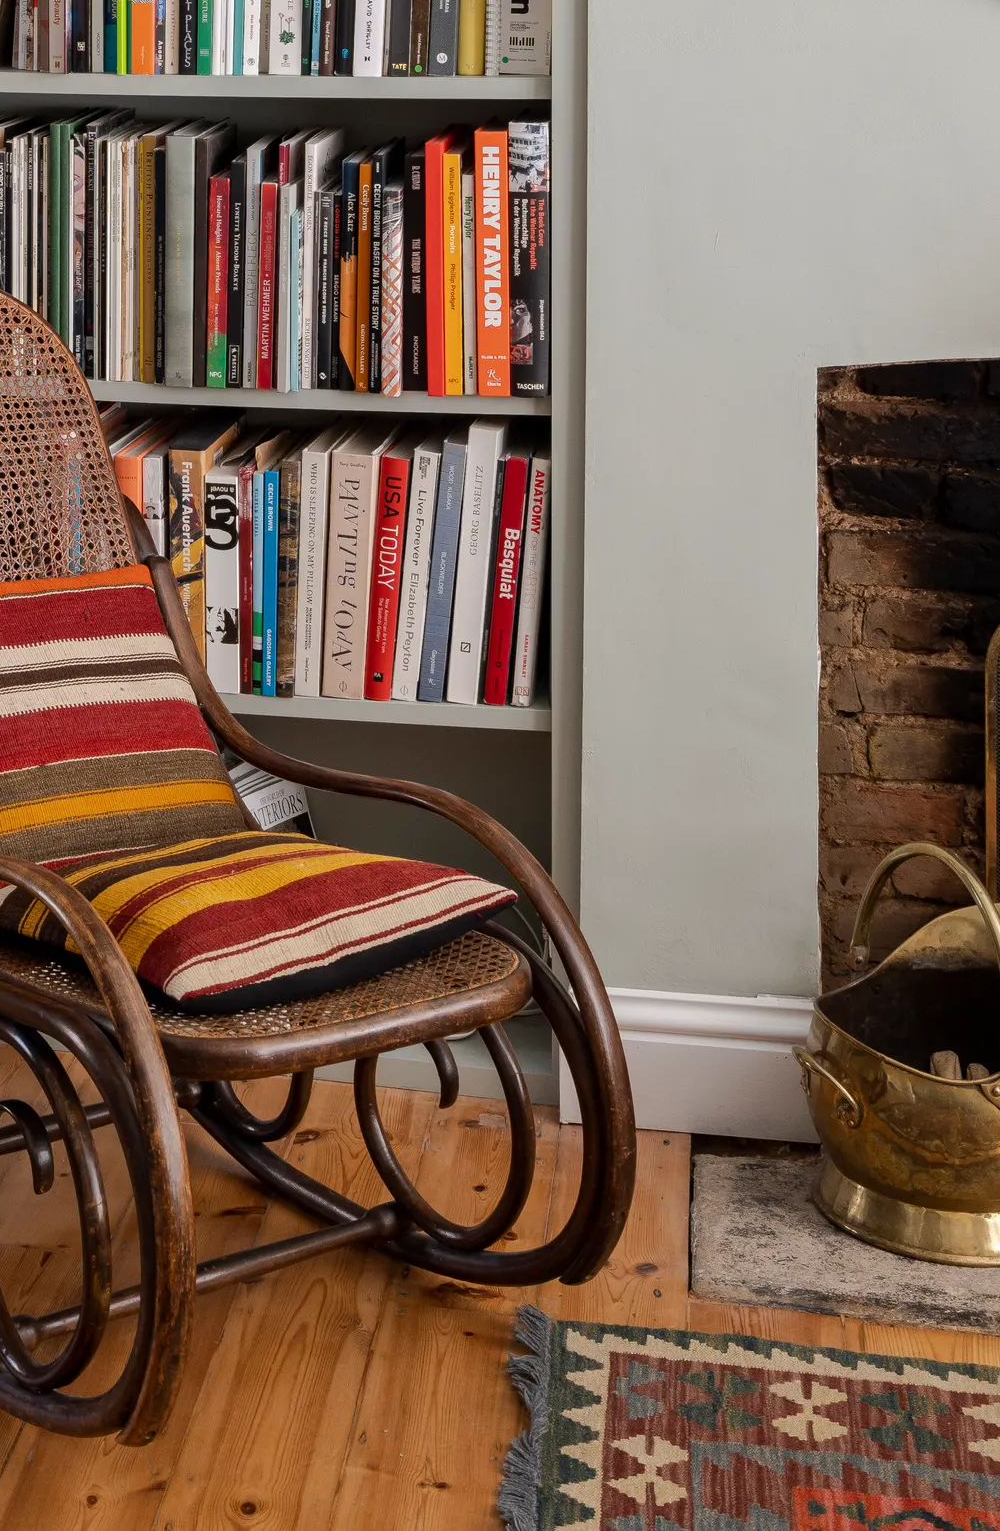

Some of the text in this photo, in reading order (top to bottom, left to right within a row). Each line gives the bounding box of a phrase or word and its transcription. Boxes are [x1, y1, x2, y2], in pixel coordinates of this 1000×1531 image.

[184, 15, 192, 68] PLACES
[348, 192, 356, 210] Alex
[482, 146, 501, 327] HENRY TAYLOR
[262, 279, 270, 359] MARTIN WEHMER
[180, 461, 192, 573] Frank Auerbach
[377, 477, 403, 590] USA TODAY
[469, 466, 484, 556] GEORG BASELITZ
[530, 469, 545, 535] ANATOMY
[402, 490, 427, 672] Live Forever Elizabeth Peyton
[499, 528, 520, 599] Basquiat
